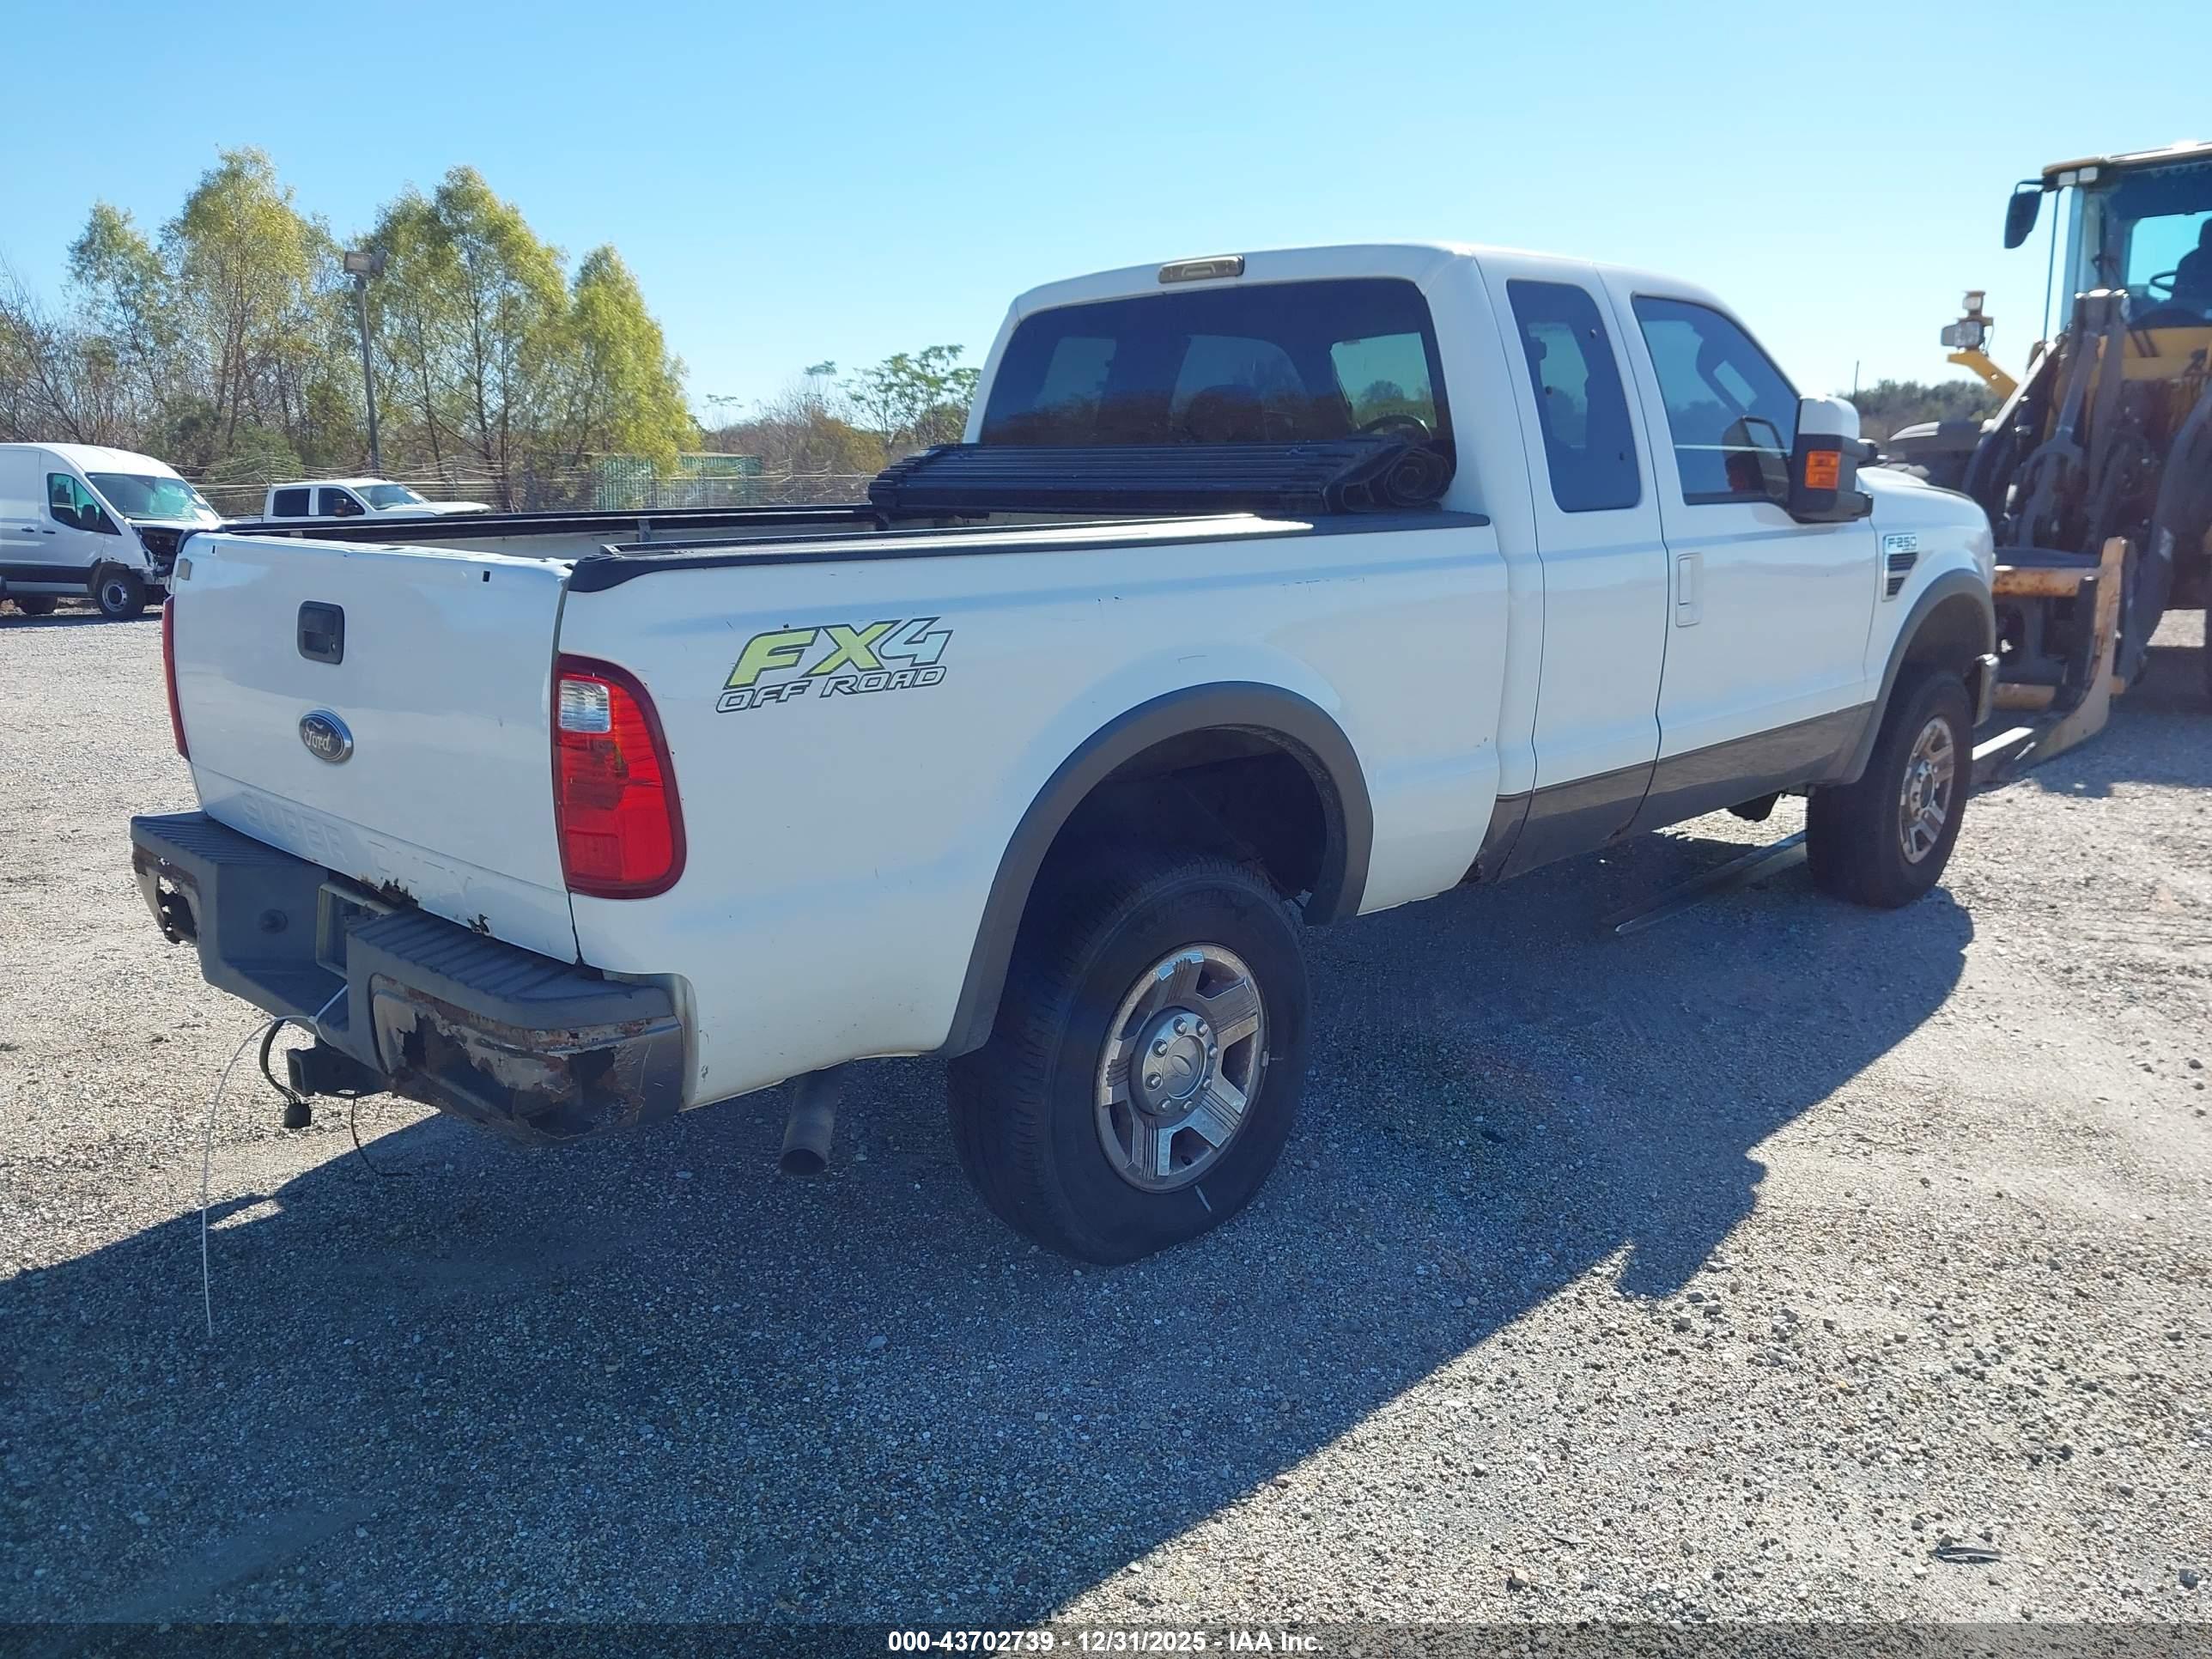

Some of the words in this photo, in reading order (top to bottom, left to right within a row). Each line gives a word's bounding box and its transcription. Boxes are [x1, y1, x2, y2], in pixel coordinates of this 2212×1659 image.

[1887, 536, 1917, 549] F250
[722, 617, 953, 690] FX4
[715, 679, 813, 713] OFF
[819, 665, 947, 698] ROAD
[304, 719, 331, 752] Ford
[241, 791, 350, 863] SUPER
